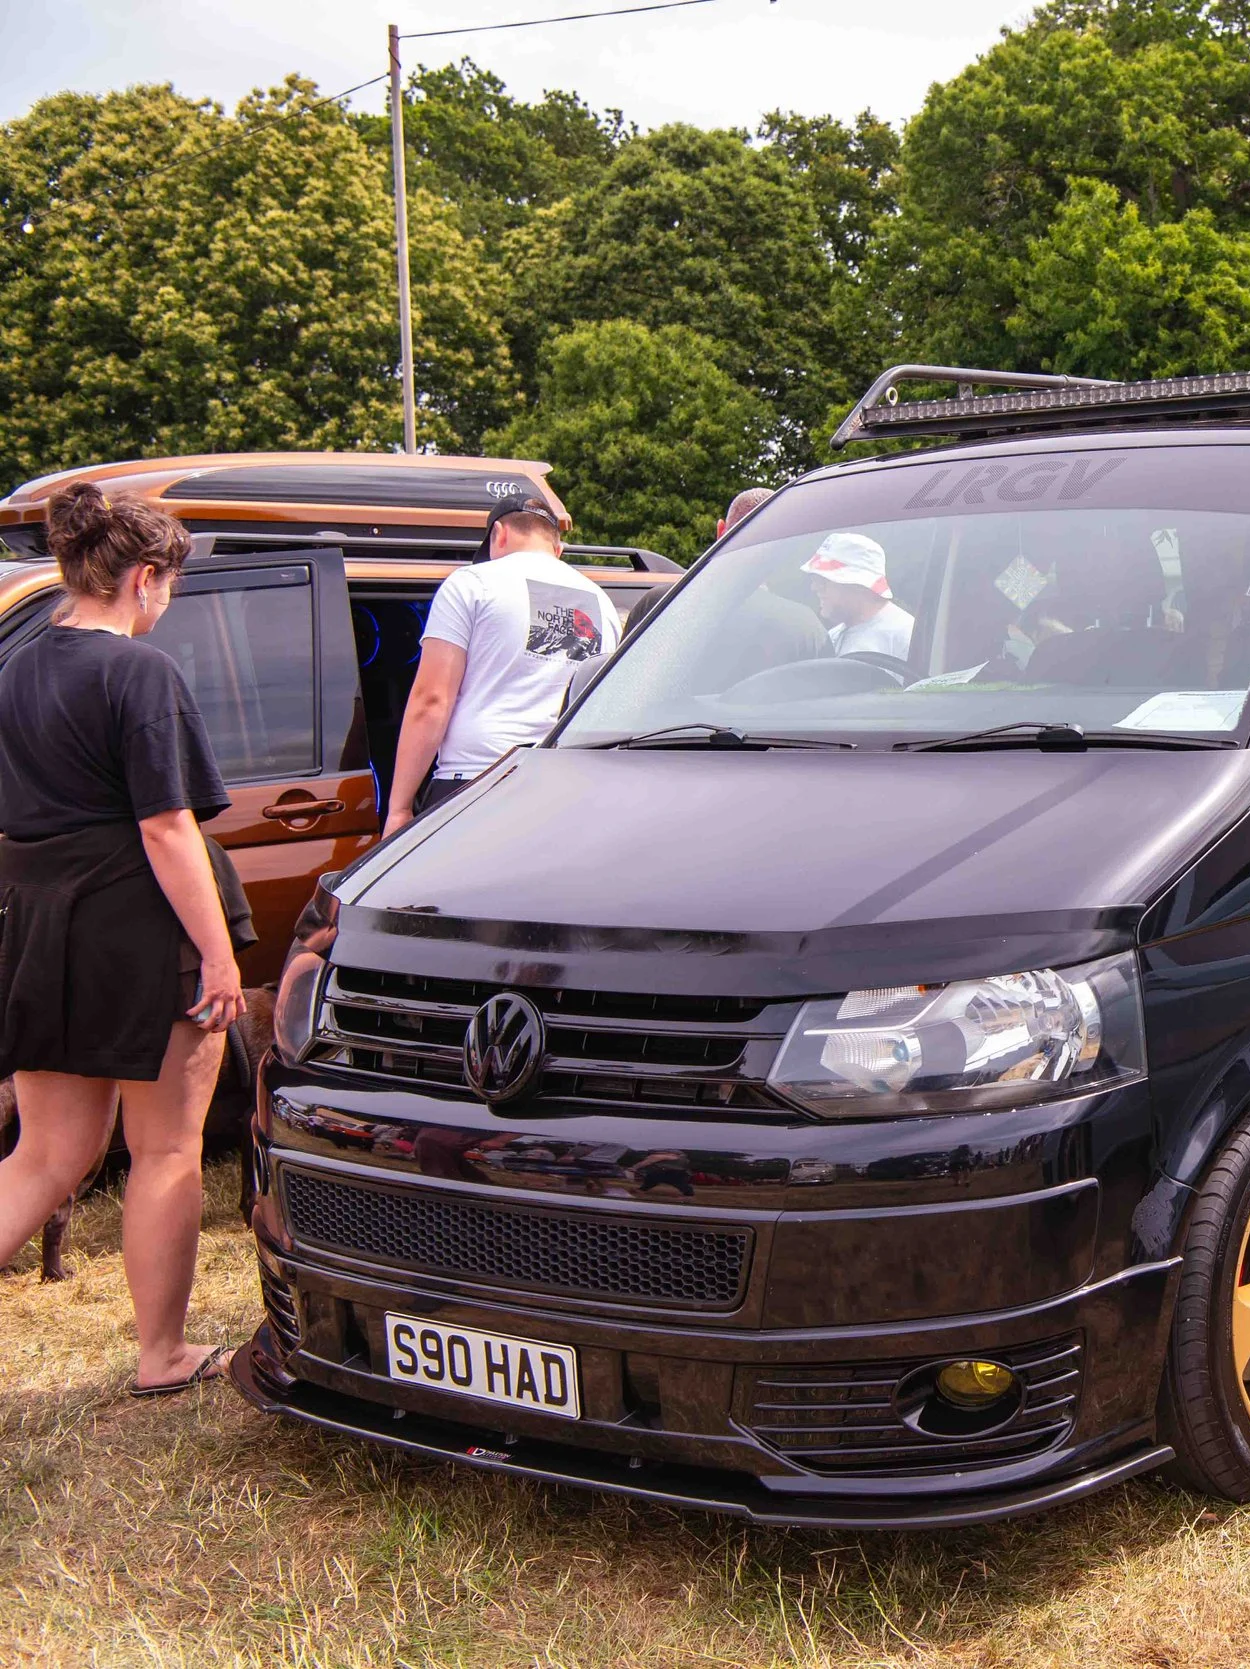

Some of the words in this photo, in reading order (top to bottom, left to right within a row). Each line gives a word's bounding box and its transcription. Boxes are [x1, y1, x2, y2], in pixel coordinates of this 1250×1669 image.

[904, 457, 1128, 510] LRGV
[537, 610, 574, 626] NORTH
[553, 605, 574, 618] THE
[547, 622, 573, 636] FACE
[394, 1323, 473, 1387] S90
[484, 1340, 569, 1407] HAD
